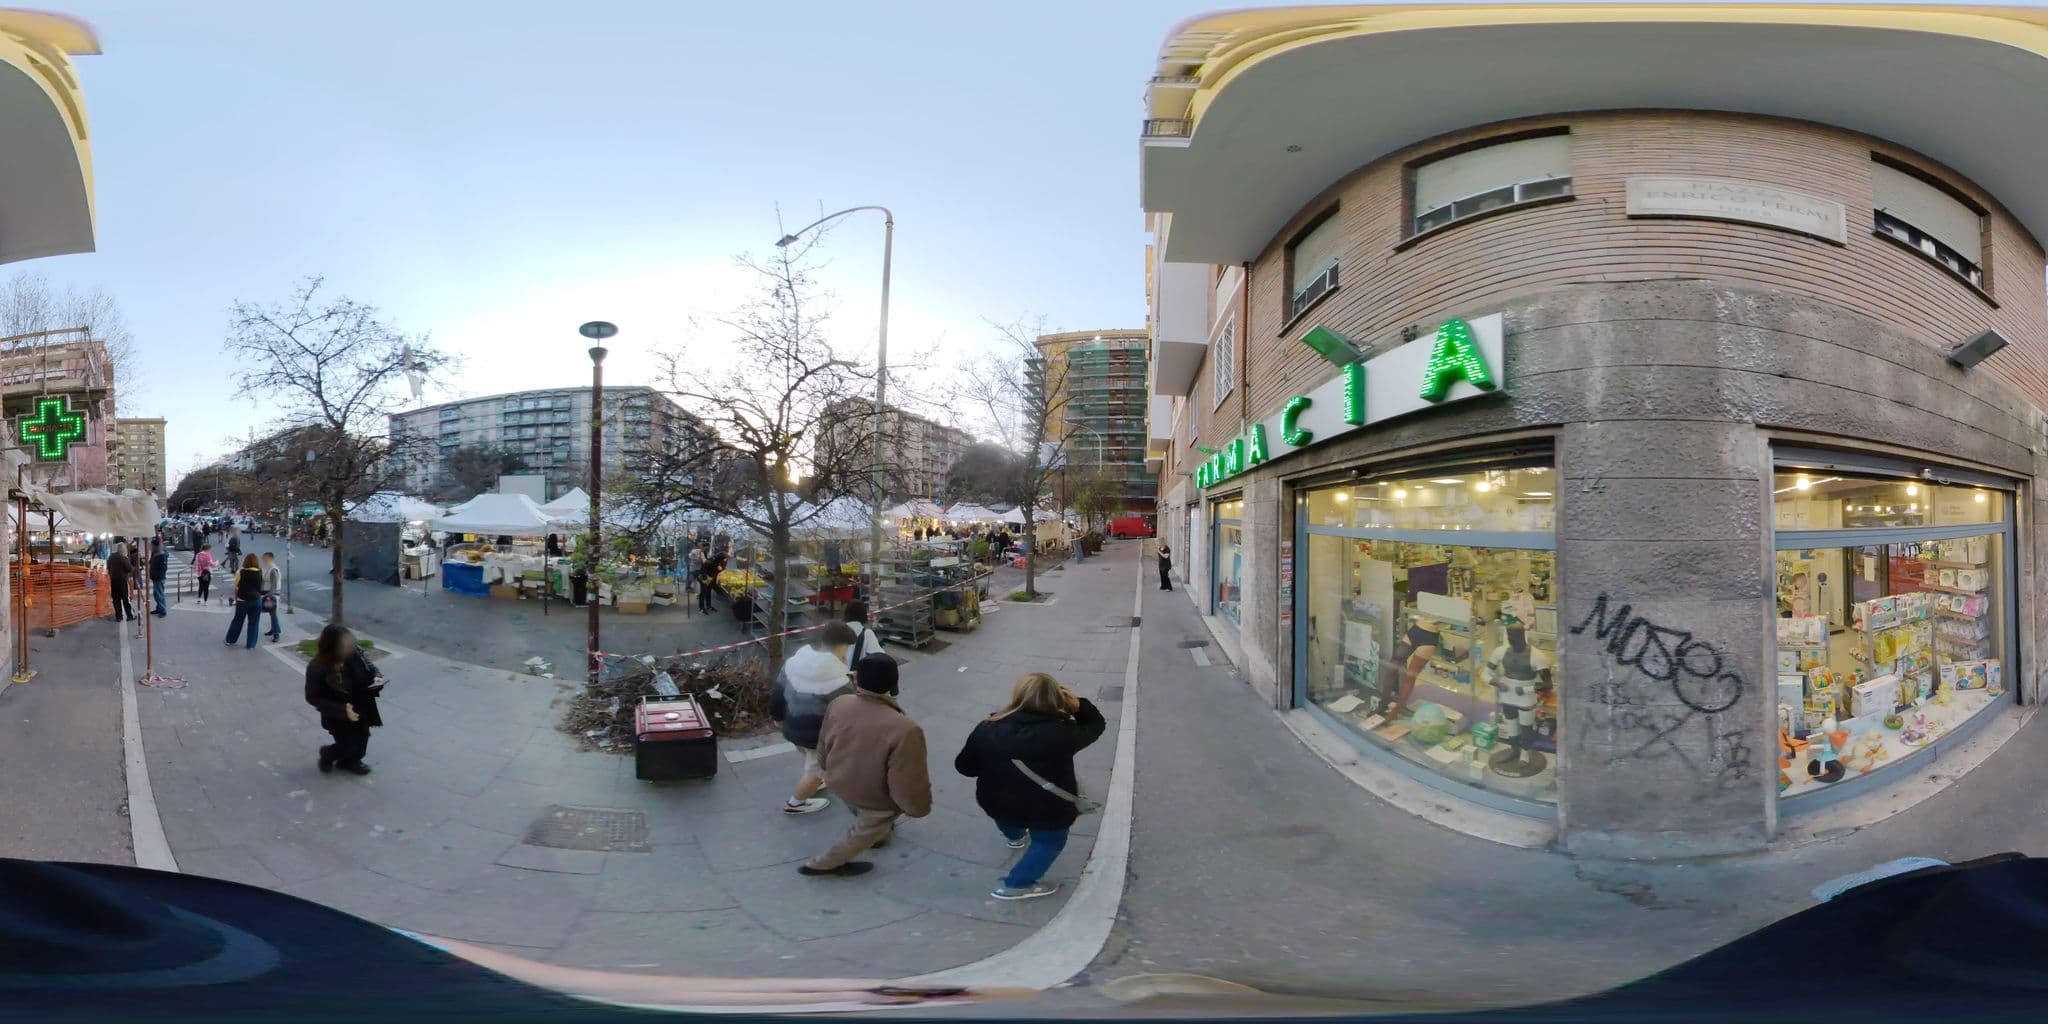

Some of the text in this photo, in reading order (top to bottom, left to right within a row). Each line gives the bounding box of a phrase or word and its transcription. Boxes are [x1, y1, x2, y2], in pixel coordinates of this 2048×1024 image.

[1647, 191, 1830, 222] ENRICO FERMI
[1692, 183, 1786, 200] PIAZZA
[1196, 316, 1497, 489] FARMACIA
